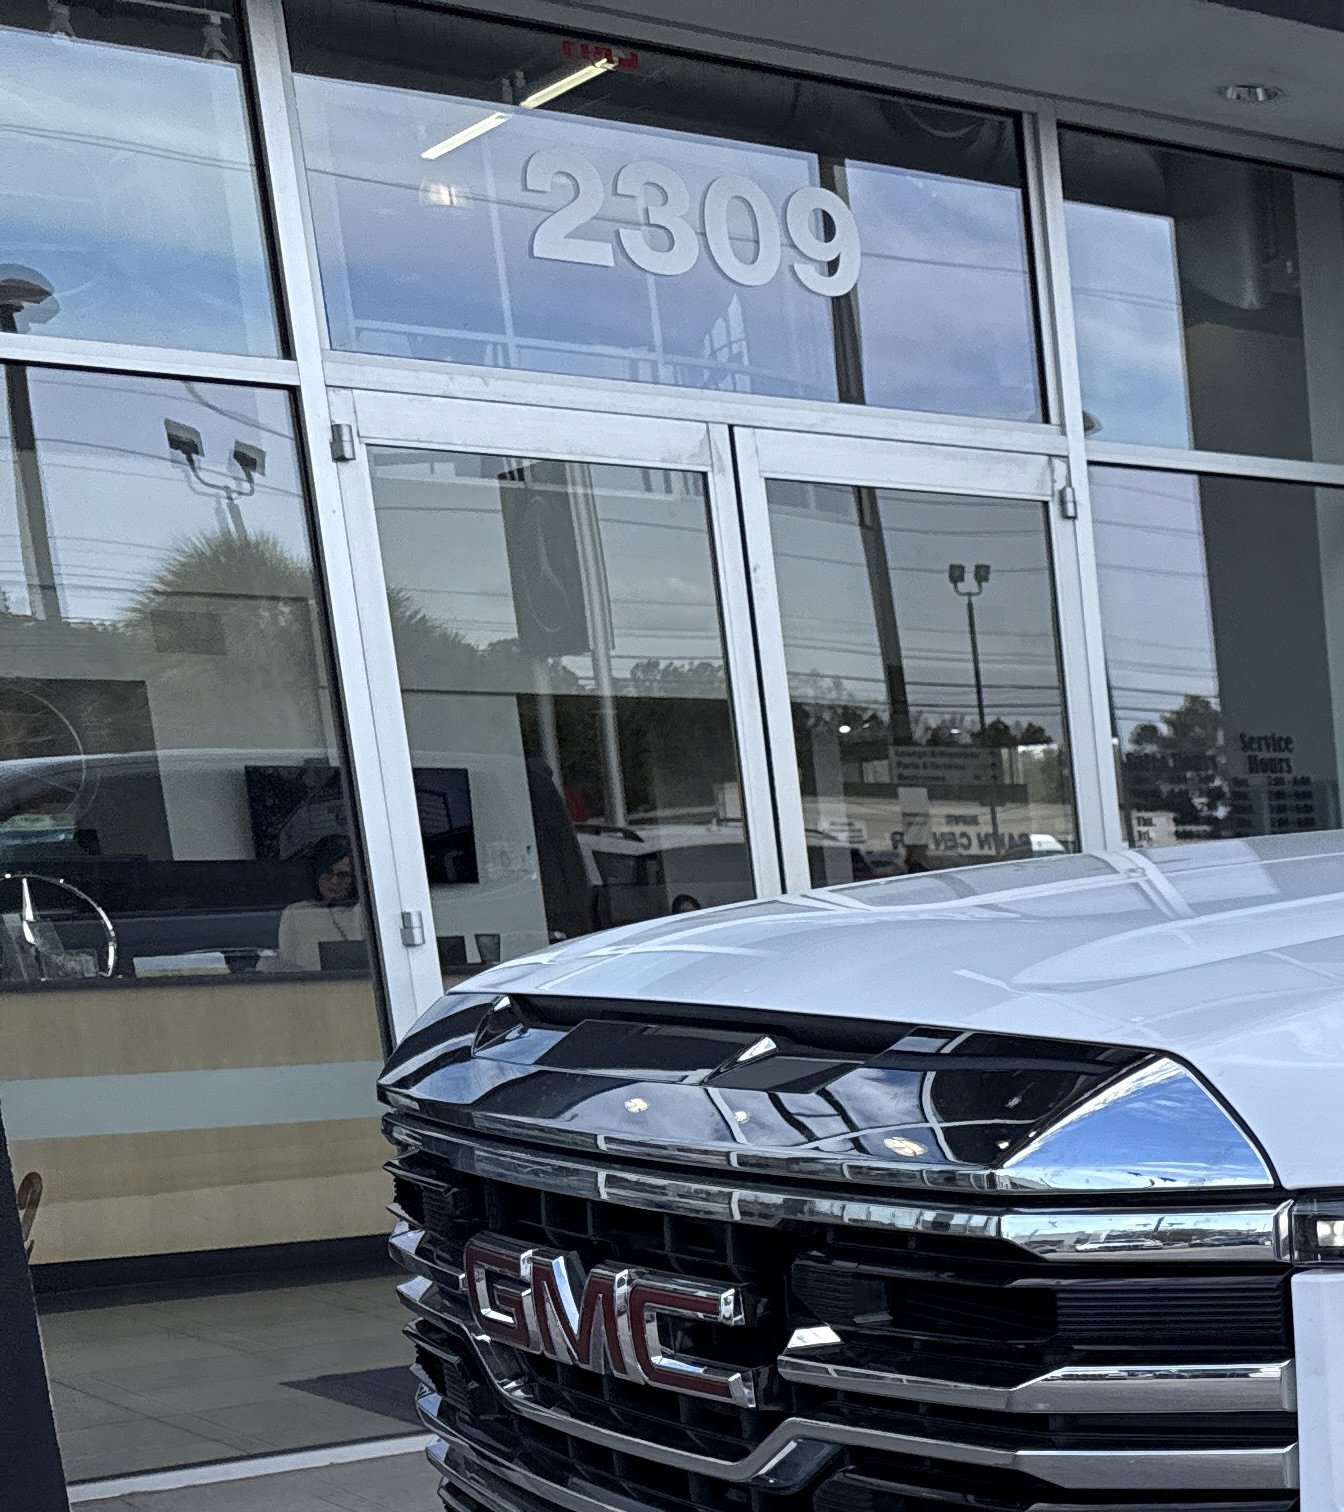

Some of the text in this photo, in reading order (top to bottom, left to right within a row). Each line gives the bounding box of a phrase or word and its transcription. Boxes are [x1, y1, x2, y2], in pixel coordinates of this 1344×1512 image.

[524, 148, 862, 297] 2309
[1239, 733, 1294, 752] Service
[1247, 755, 1293, 774] Hours
[463, 1230, 758, 1410] GMC
